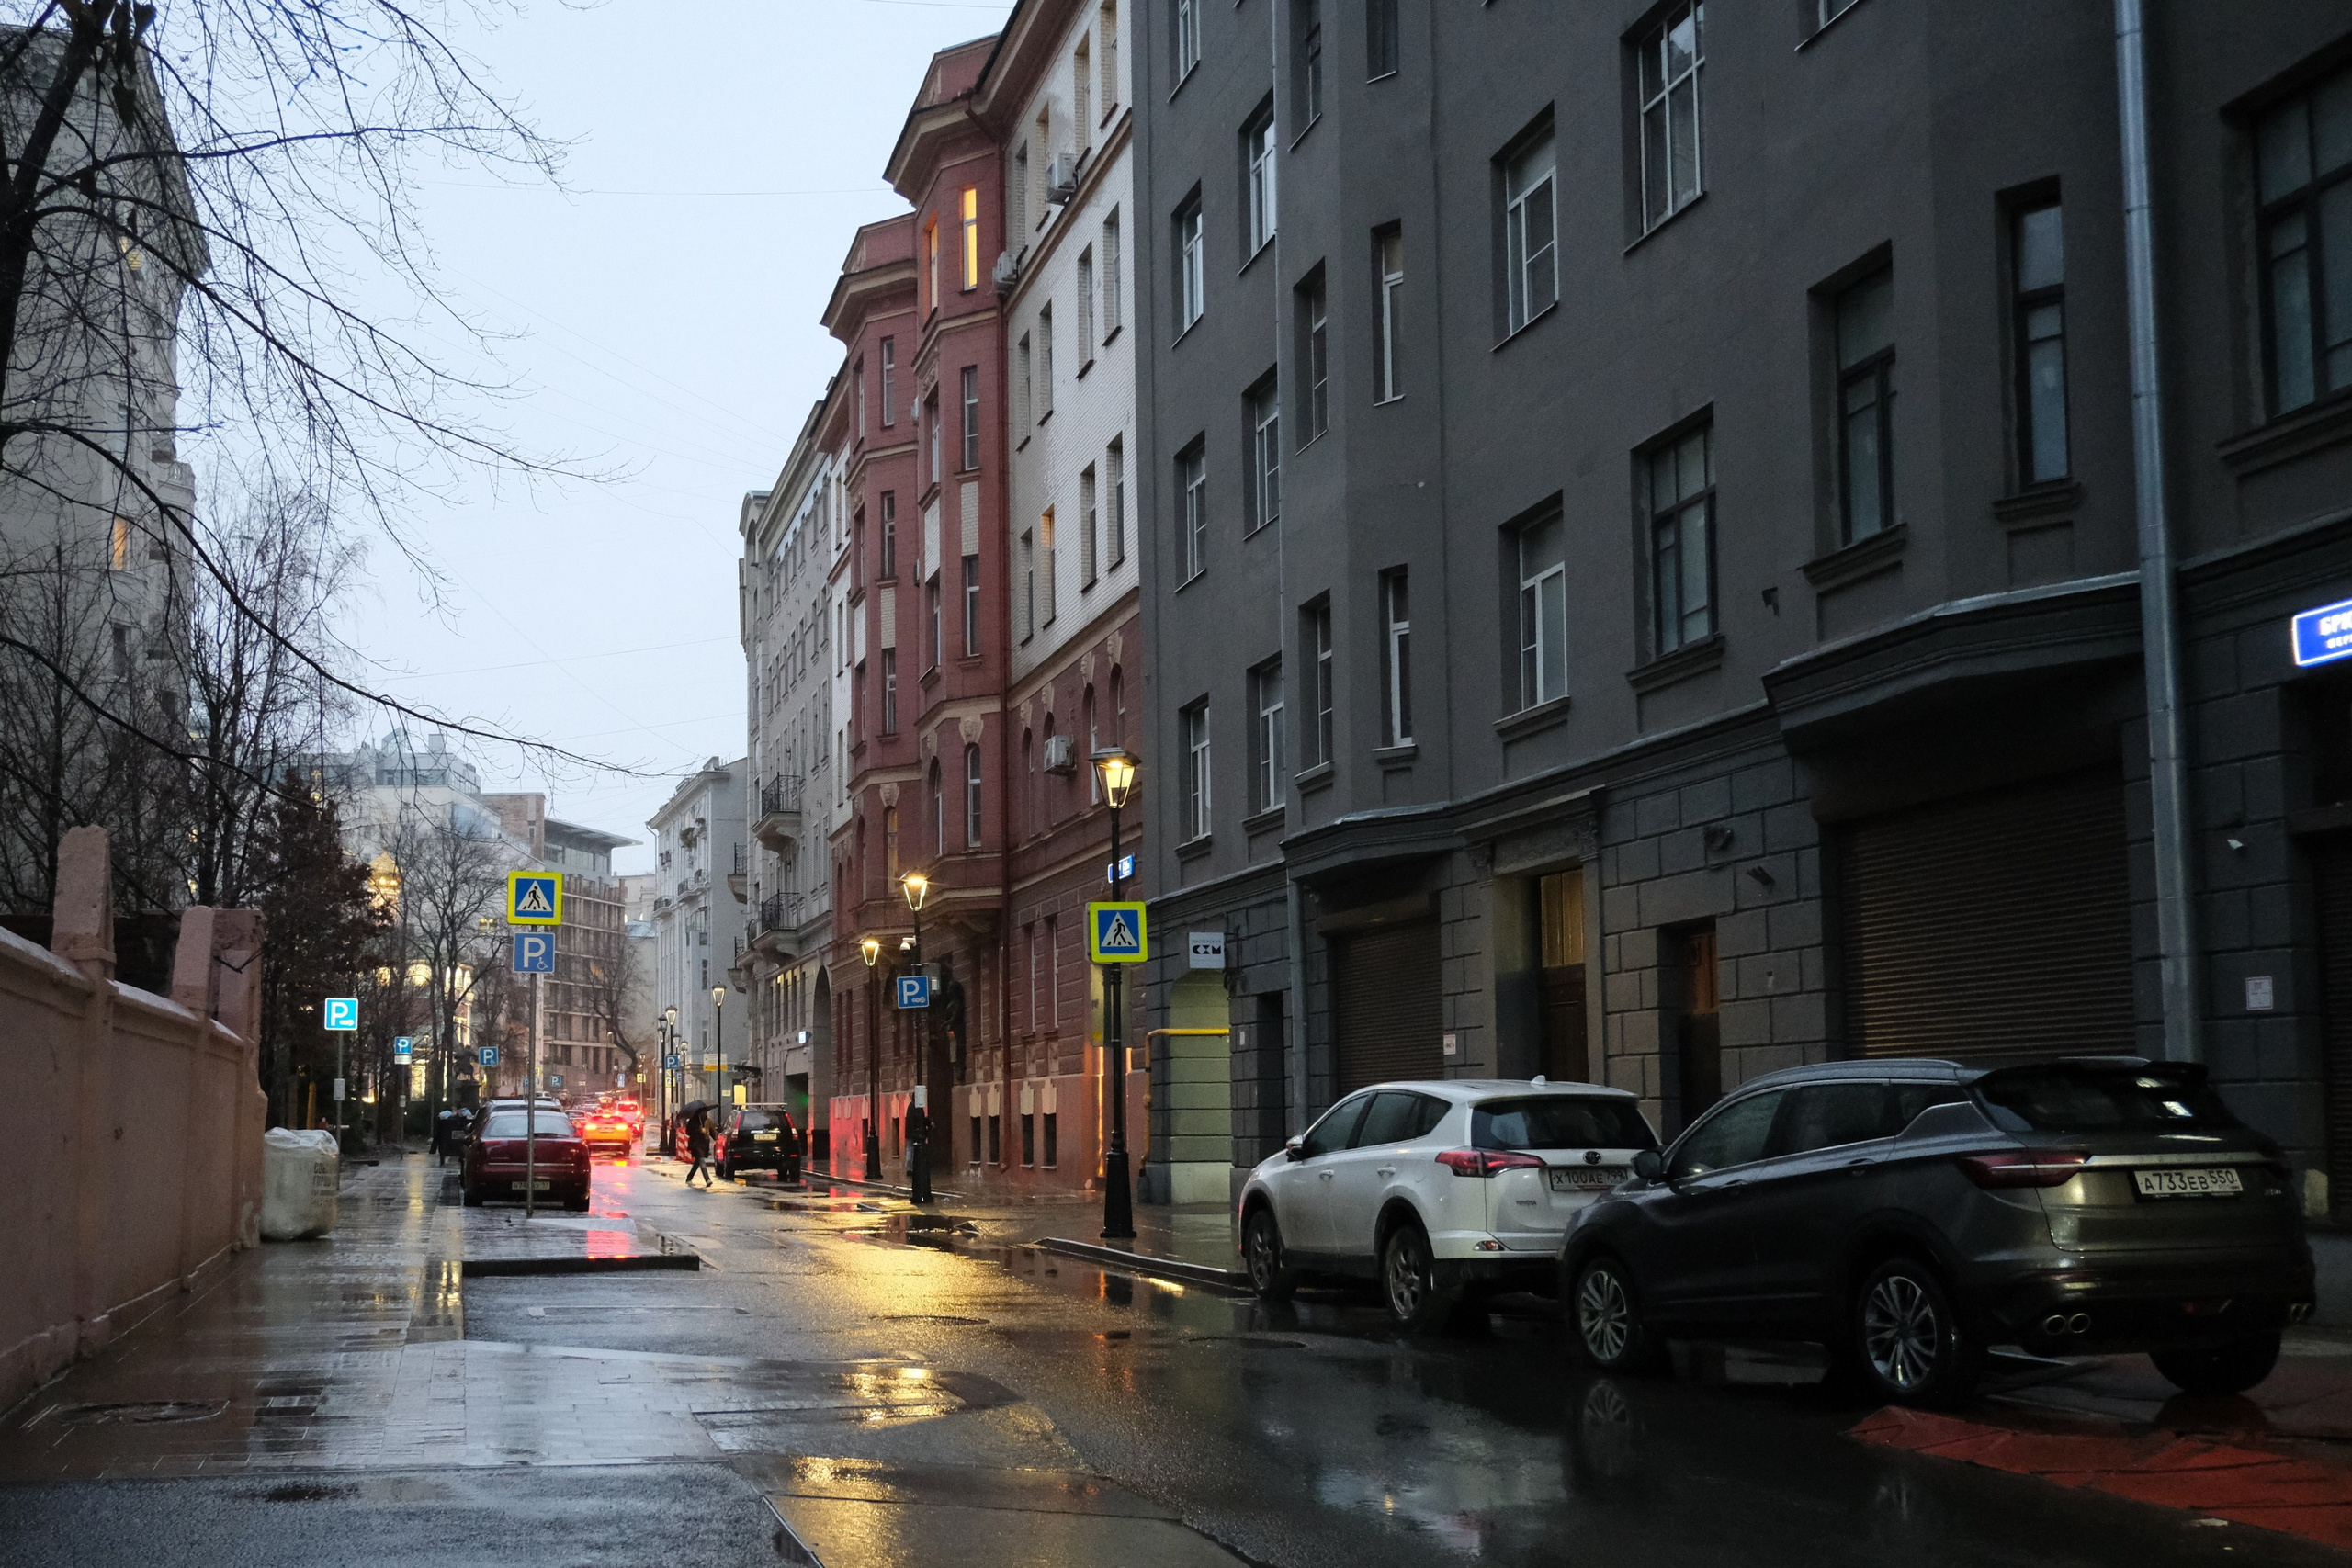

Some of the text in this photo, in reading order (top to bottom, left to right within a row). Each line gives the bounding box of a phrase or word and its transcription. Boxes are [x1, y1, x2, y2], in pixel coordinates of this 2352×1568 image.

[523, 937, 546, 968] P
[903, 980, 920, 1004] P
[331, 1002, 349, 1026] P
[483, 1049, 494, 1064] P
[667, 1057, 675, 1068] P
[2209, 1169, 2233, 1184] 550
